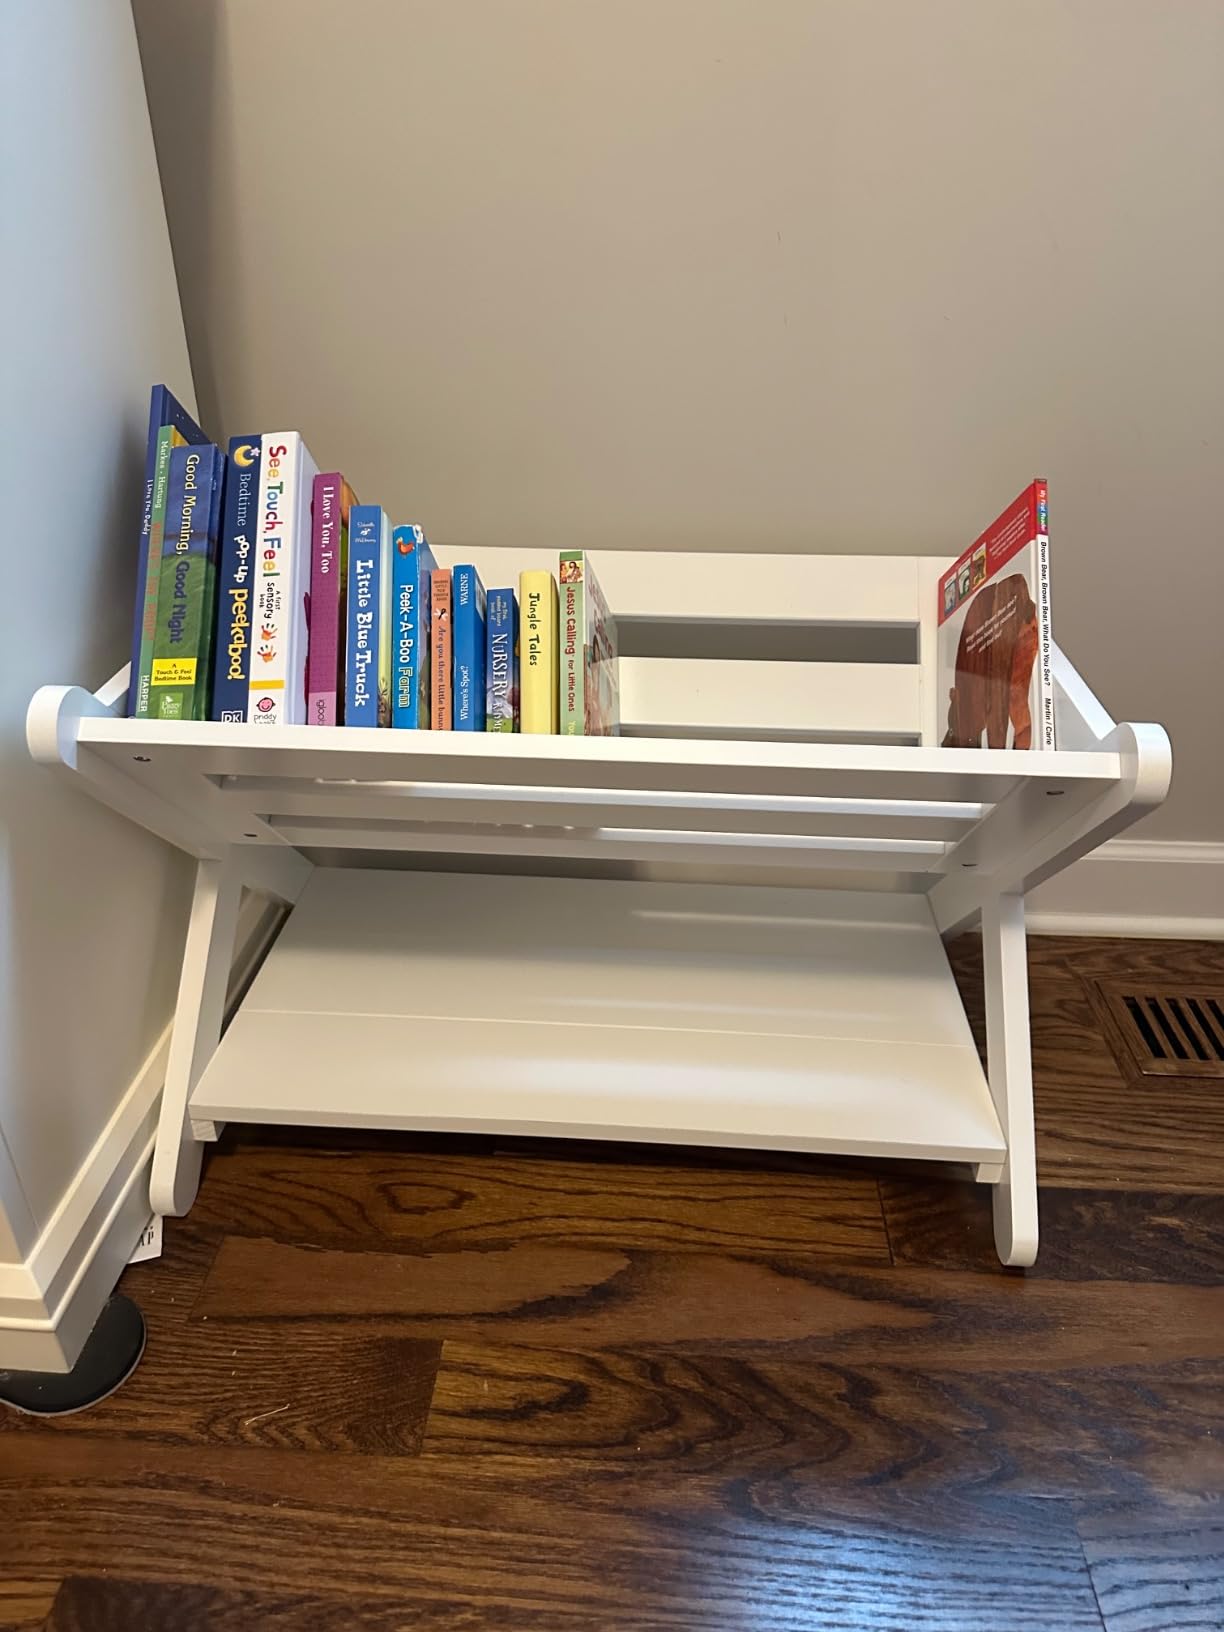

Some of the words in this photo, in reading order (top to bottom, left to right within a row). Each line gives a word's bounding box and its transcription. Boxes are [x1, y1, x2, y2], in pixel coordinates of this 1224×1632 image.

[185, 454, 200, 490] Good
[266, 445, 287, 480] See,
[155, 476, 166, 508] Hartung
[237, 474, 252, 526] Bedtime
[263, 482, 284, 534] Touch,
[322, 494, 334, 519] Love
[176, 496, 196, 554] Morning,
[320, 522, 334, 548] You,
[234, 535, 250, 583] pop-up
[262, 537, 282, 577] Feel
[320, 551, 332, 574] Too
[174, 561, 190, 599] Good
[356, 560, 374, 607] Little
[460, 573, 468, 606] WARNE
[528, 592, 541, 630] Jungle
[566, 586, 576, 616] Jesus
[168, 604, 186, 644] Night
[227, 588, 250, 680] peekaboo!
[356, 612, 373, 648] Blue
[399, 584, 414, 664] Peek-A-Boo
[565, 618, 576, 656] Calling
[529, 634, 542, 666] Tales
[1044, 642, 1049, 652] Do
[354, 650, 372, 706] Truck
[460, 666, 470, 688] Spot?
[492, 634, 508, 699] NURSERY
[140, 675, 150, 712] HARPER
[398, 666, 413, 708] Farm
[460, 688, 468, 720] Where's
[224, 712, 241, 722] DK
[254, 714, 277, 723] priddy
